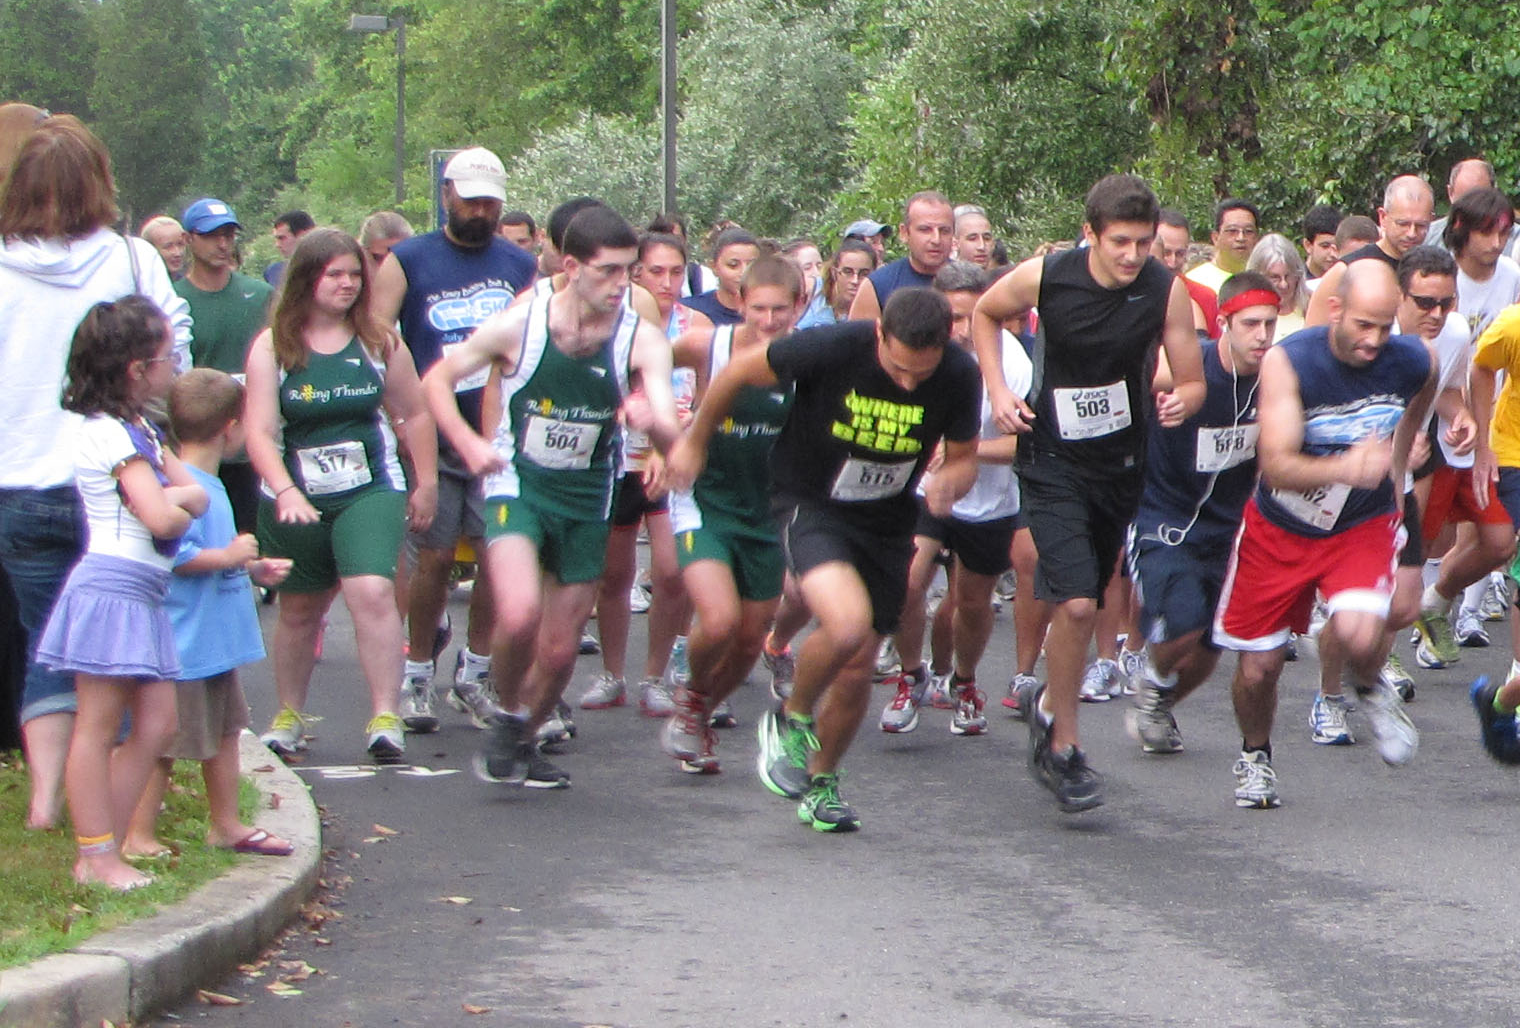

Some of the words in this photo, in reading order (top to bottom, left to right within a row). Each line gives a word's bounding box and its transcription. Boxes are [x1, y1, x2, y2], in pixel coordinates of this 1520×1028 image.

[480, 300, 506, 317] 5K
[851, 395, 924, 425] WHERE
[1076, 399, 1110, 418] 503
[852, 414, 875, 431] IS
[877, 419, 911, 437] MY
[545, 433, 580, 451] 504
[318, 454, 347, 474] 517
